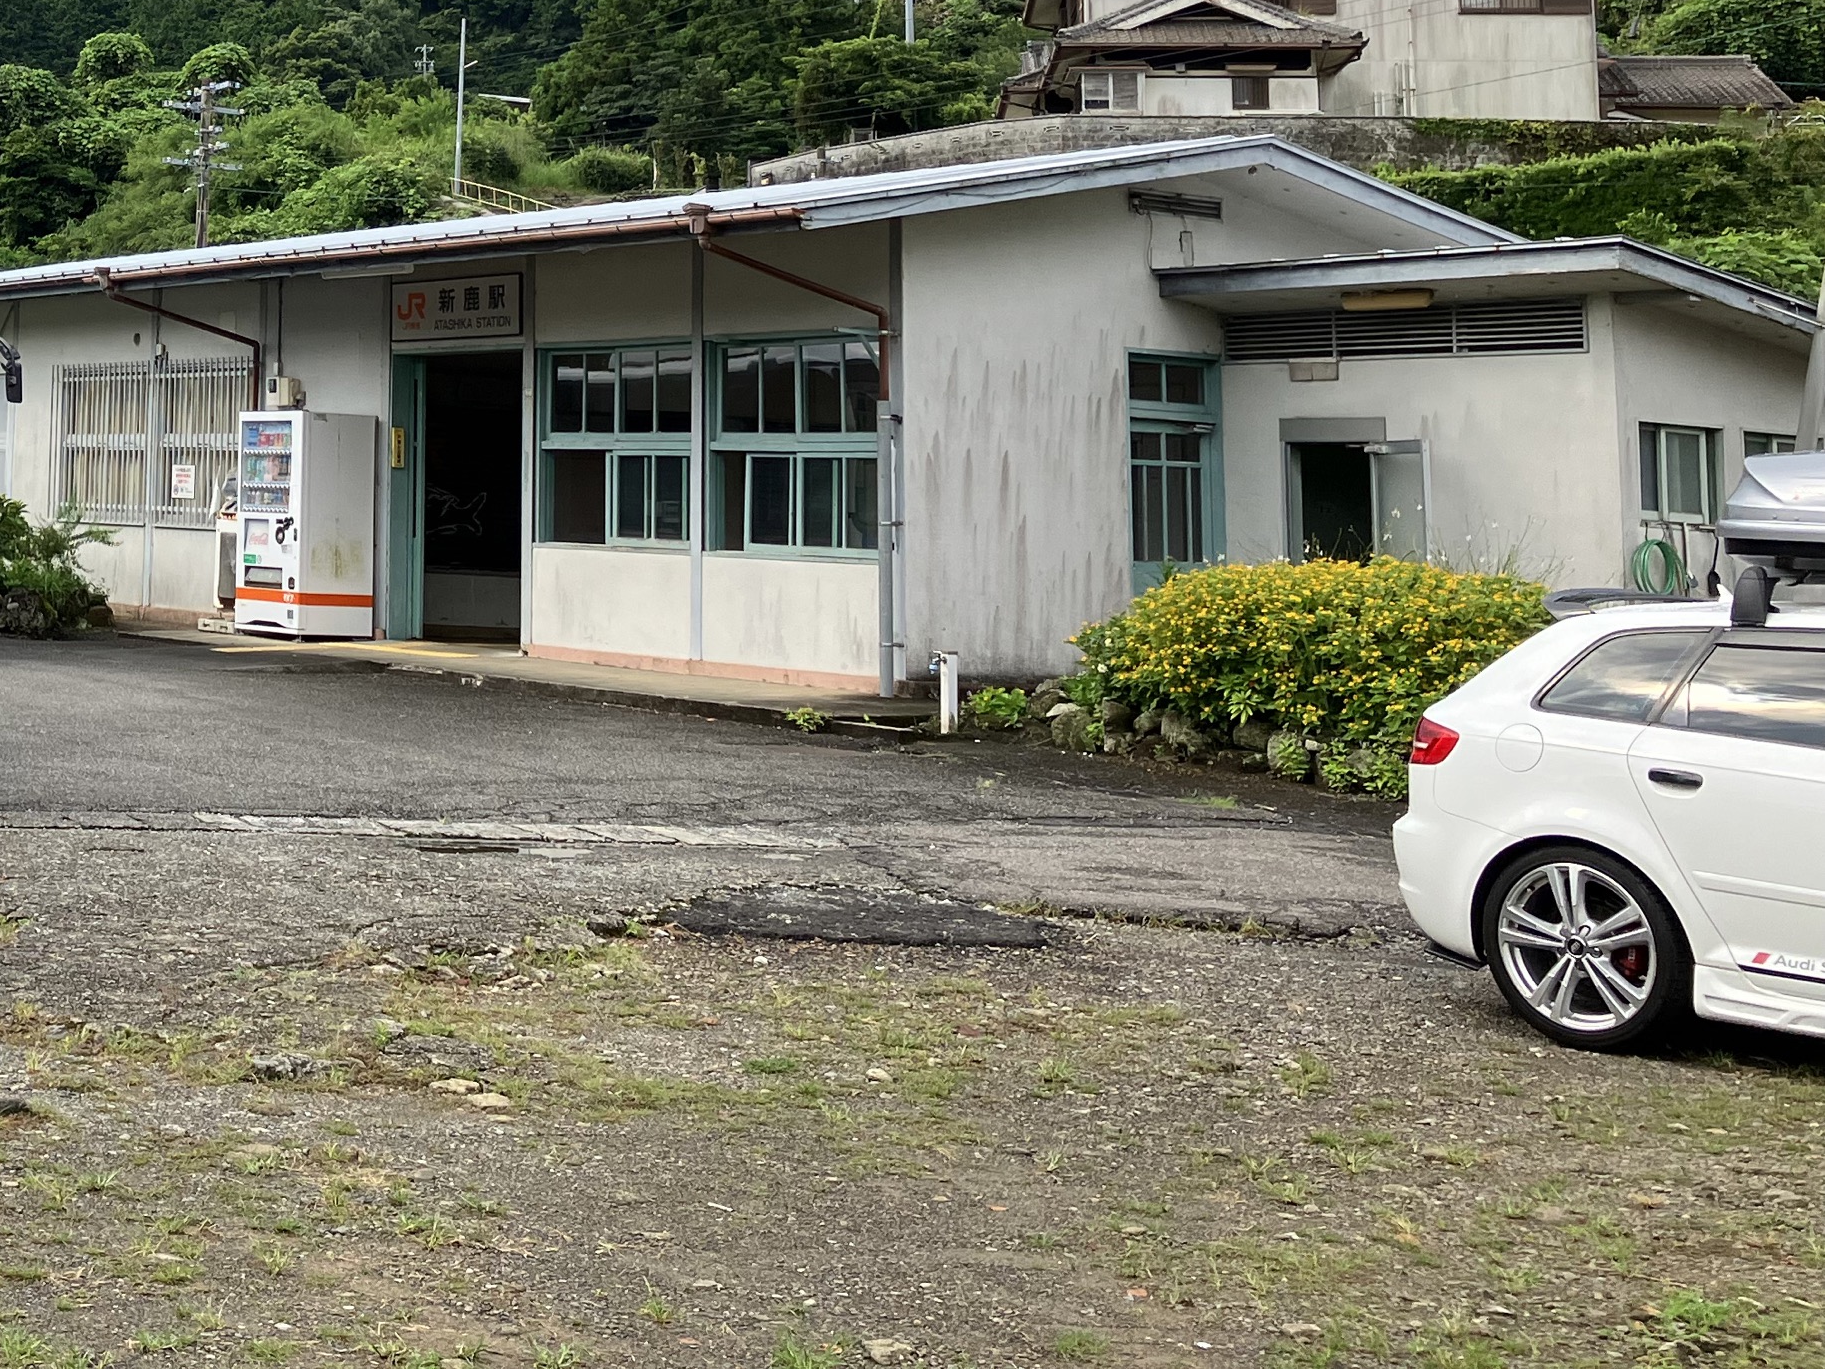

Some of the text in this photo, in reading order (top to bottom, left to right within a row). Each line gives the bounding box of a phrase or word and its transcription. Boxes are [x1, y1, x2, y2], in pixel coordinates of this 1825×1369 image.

[397, 293, 426, 320] JR
[438, 284, 506, 313] 新鹿駅
[434, 317, 473, 331] ATASHIKA
[476, 315, 512, 329] STATION
[1774, 954, 1816, 971] Audi
